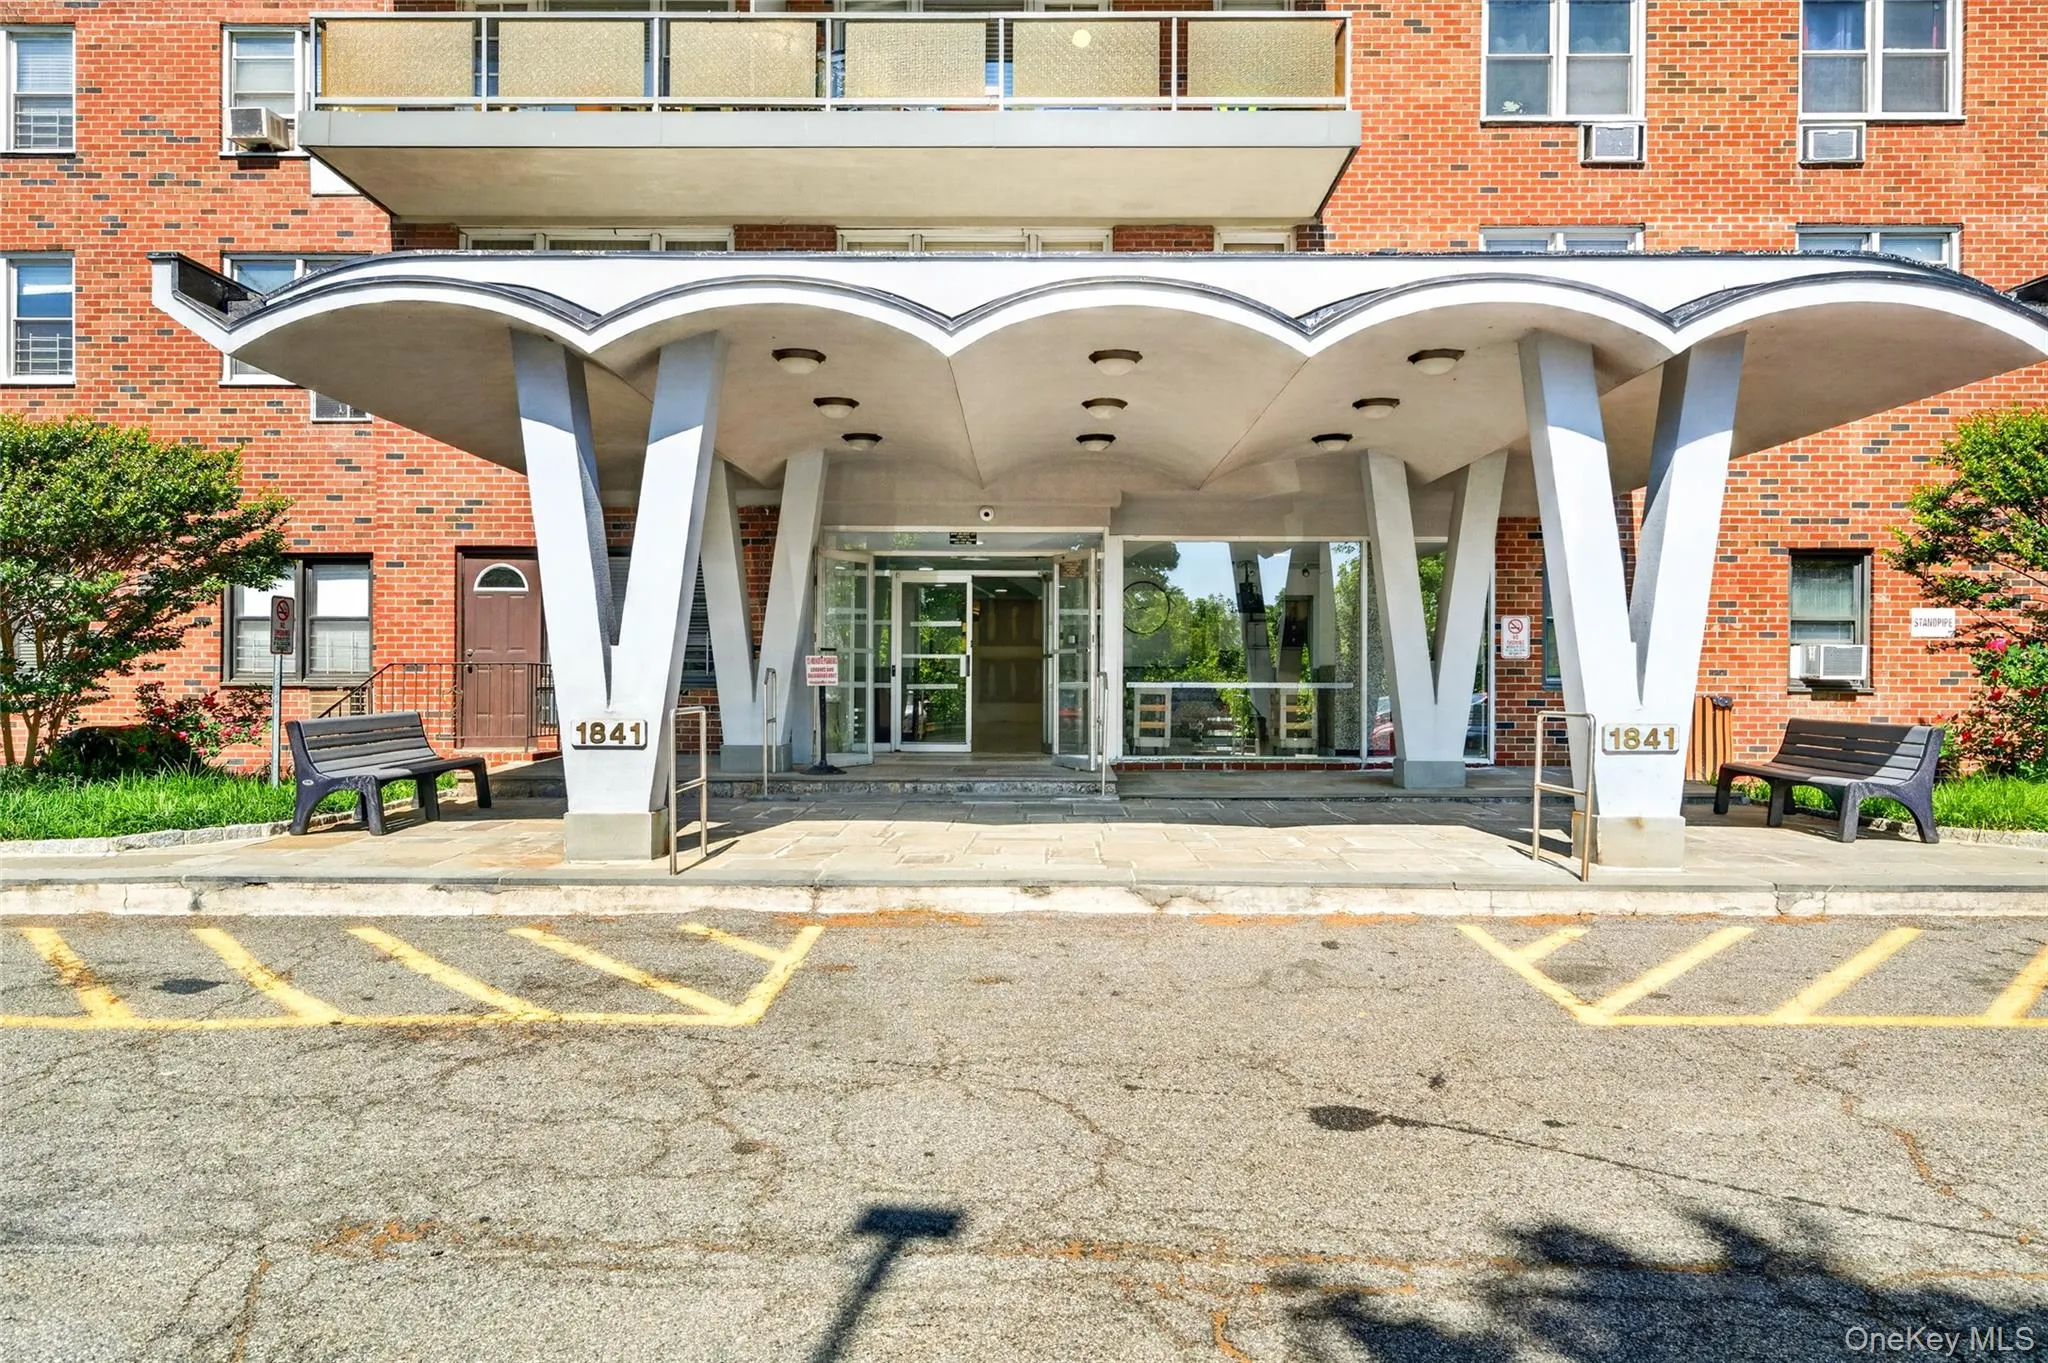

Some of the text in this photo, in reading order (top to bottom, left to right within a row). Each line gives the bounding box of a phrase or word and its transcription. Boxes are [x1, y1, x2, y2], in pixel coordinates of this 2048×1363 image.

[1914, 617, 1953, 628] STANDPIPE
[576, 722, 640, 744] 1841
[1609, 727, 1674, 750] 1841
